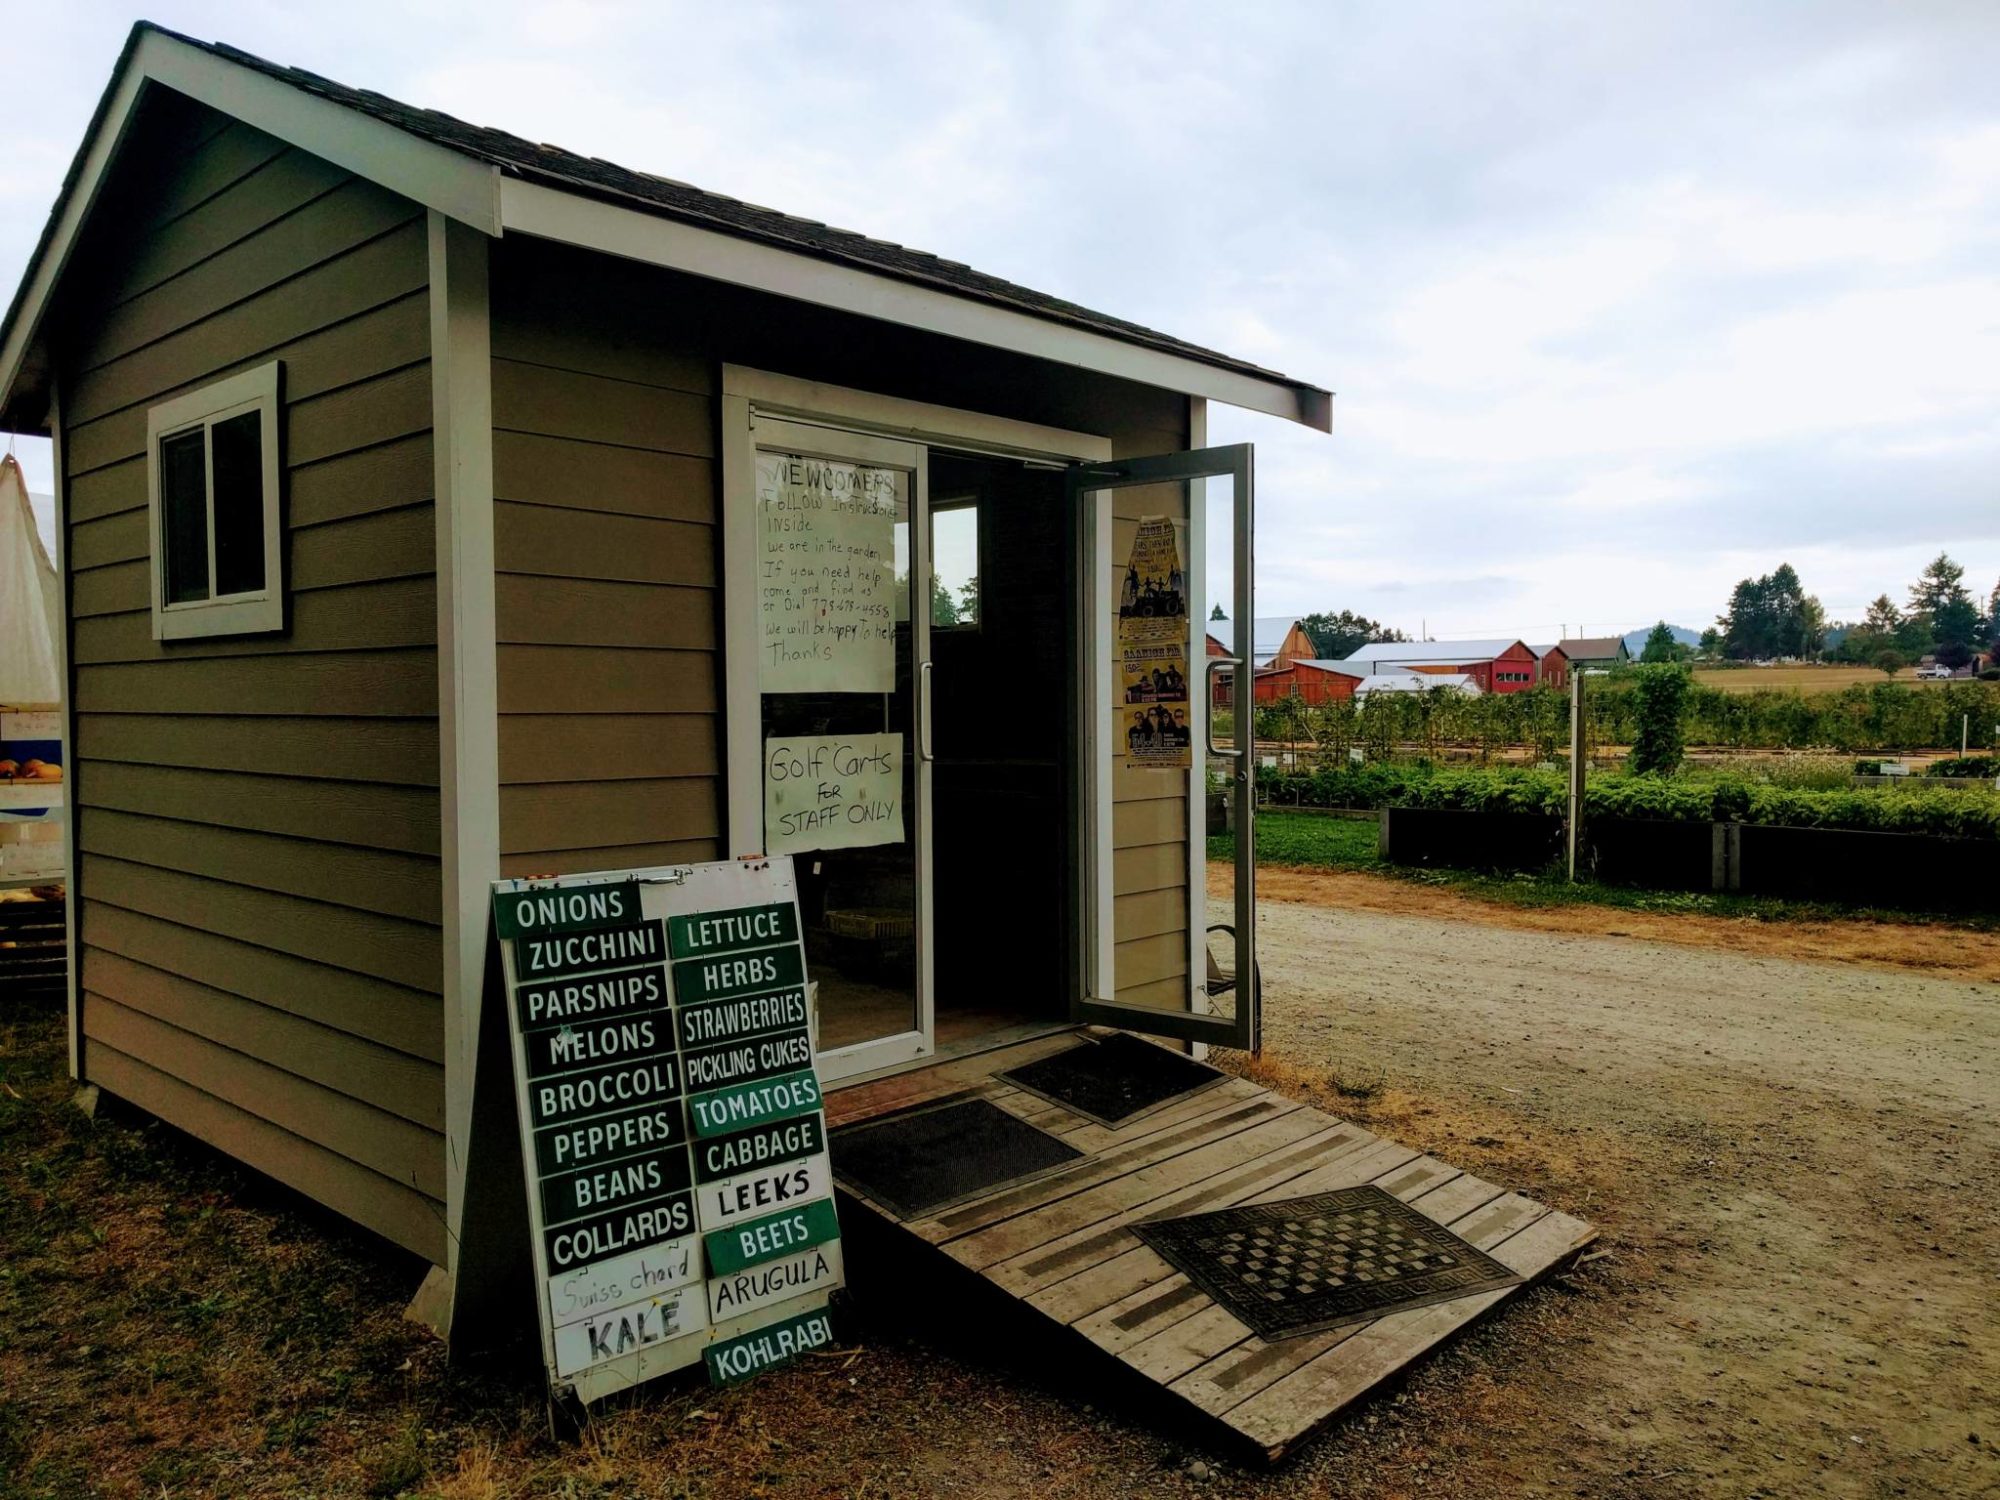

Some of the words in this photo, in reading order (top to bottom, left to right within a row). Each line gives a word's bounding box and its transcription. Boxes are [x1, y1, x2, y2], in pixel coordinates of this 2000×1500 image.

[762, 559, 785, 578] If
[790, 567, 815, 584] you
[822, 564, 850, 578] need
[858, 566, 881, 588] help
[789, 541, 809, 553] are
[847, 543, 881, 563] garden
[762, 602, 775, 612] or
[784, 596, 805, 612] Dial
[763, 586, 791, 597] come
[801, 580, 819, 596] and
[831, 579, 854, 597] find
[765, 638, 833, 668] Thanks
[787, 618, 809, 635] will
[813, 615, 825, 635] be
[828, 619, 858, 643] happy
[875, 621, 896, 646] help
[770, 746, 828, 781] Golf
[833, 744, 892, 777] Carts
[779, 804, 840, 836] STAFF
[848, 800, 895, 824] ONLY
[517, 890, 624, 928] ONIONS
[687, 912, 781, 948] LETTUCE
[529, 928, 656, 971] ZUCCHINI
[703, 956, 777, 991] HERBS
[529, 975, 659, 1021] PARSNIPS
[685, 993, 804, 1042] STRAWBERRIES
[550, 1021, 655, 1065] MELONS
[688, 1047, 754, 1085] PICKLING
[761, 1037, 809, 1066] CUKES
[540, 1064, 675, 1117] BROCCOLI
[695, 1078, 817, 1128] TOMATOES
[554, 1112, 670, 1163] PEPPERS
[707, 1123, 813, 1172] CABBAGE
[575, 1161, 661, 1208] BEANS
[718, 1169, 809, 1217] LEEKS
[553, 1202, 689, 1265] COLLARDS
[739, 1215, 808, 1259] BEETS
[558, 1280, 623, 1316] Swiss
[630, 1248, 689, 1289] chard
[716, 1253, 829, 1313] ARUGULA
[588, 1300, 681, 1361] KALE
[715, 1316, 832, 1381] KOHLRABI
